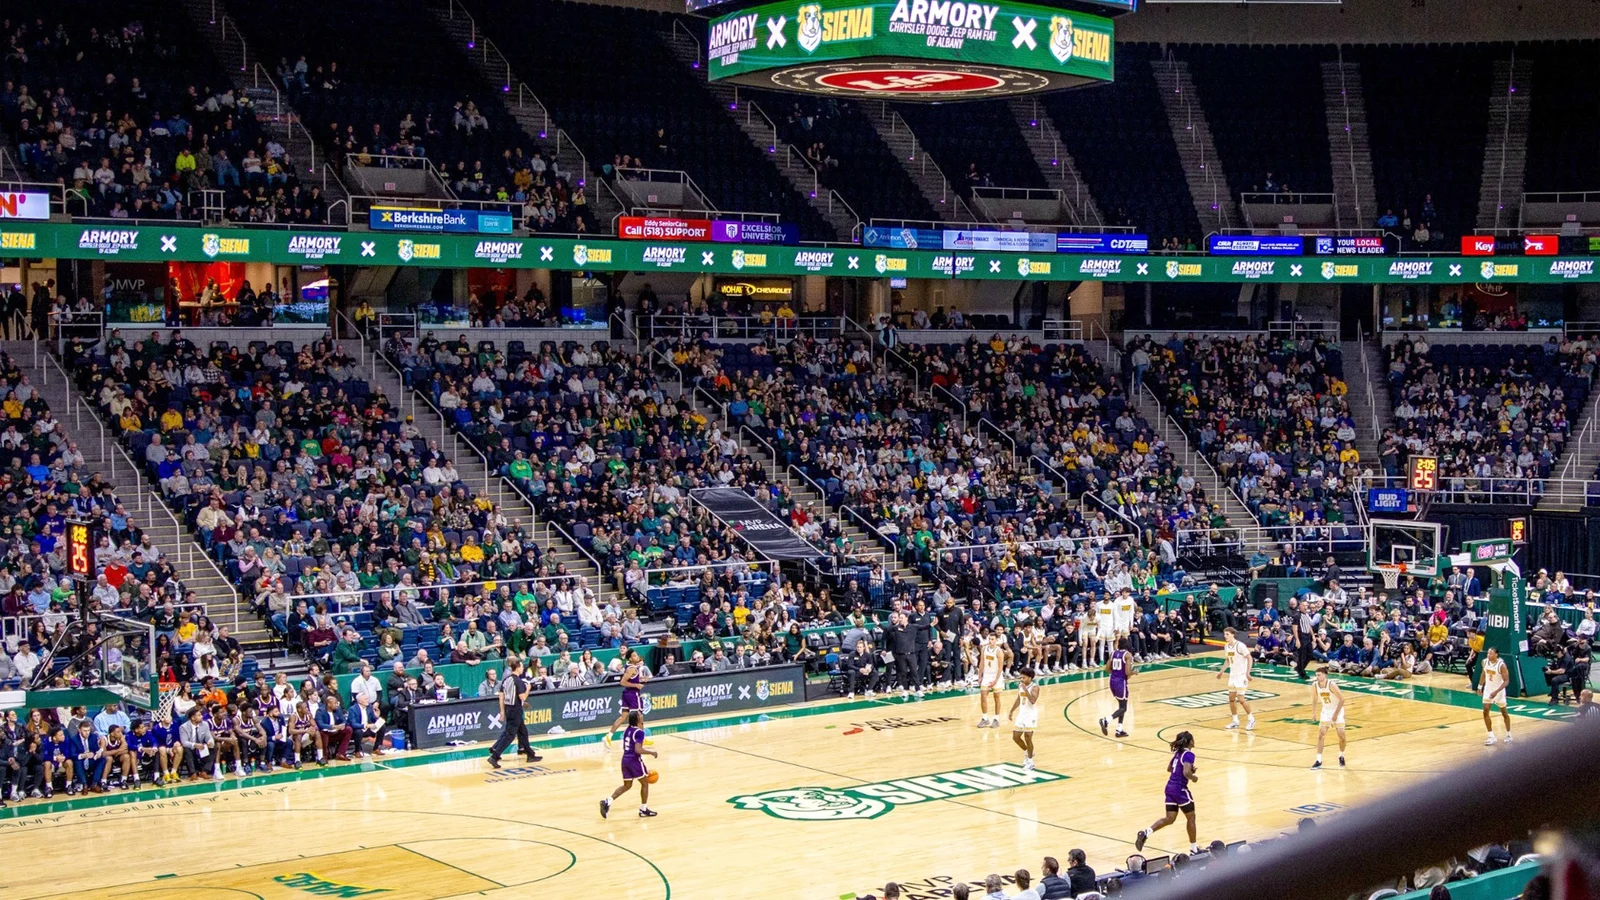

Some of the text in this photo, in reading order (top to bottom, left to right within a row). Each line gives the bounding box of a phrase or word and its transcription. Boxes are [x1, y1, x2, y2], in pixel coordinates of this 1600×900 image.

[709, 13, 758, 50] ARMORY
[821, 7, 873, 42] SIENA
[889, 0, 999, 30] ARMORY
[1073, 29, 1110, 62] SIENA
[889, 21, 997, 41] CHRYSLER DODGE JEEP RAM FIAT
[927, 36, 964, 49] OF ALBANY
[625, 226, 706, 238] Call (518) SUPPORT
[659, 220, 688, 228] SeniorCare
[742, 224, 782, 233] EXCELSIOR
[1, 232, 35, 249] SIENA
[80, 230, 138, 244] ARMORY
[219, 239, 249, 254] SIENA
[742, 232, 787, 241] UNIVERSITY
[1110, 239, 1135, 249] CDTA
[289, 236, 342, 249] ARMORY
[413, 244, 440, 258] SIENA
[475, 242, 523, 254] ARMORY
[587, 249, 612, 263] SIENA
[643, 247, 687, 259] ARMORY
[744, 254, 767, 267] SIENA
[795, 252, 834, 263] ARMORY
[886, 258, 907, 271] SIENA
[933, 257, 974, 267] ARMORY
[1029, 262, 1051, 274] SIENA
[1080, 260, 1122, 271] ARMORY
[1178, 264, 1202, 276] SIENA
[1232, 262, 1275, 272] ARMORY
[1335, 265, 1358, 277] SIENA
[1390, 262, 1433, 272] ARMORY
[1494, 265, 1518, 276] SIENA
[1550, 261, 1594, 271] ARMORY
[116, 279, 145, 290] MVP
[1417, 459, 1435, 470] 2:05
[1414, 470, 1433, 488] 25
[1374, 500, 1401, 508] LIGHT
[1378, 493, 1398, 501] BUD
[746, 522, 783, 531] ARENA
[1511, 576, 1520, 634] TicketSmarter
[1112, 658, 1122, 670] 00
[687, 683, 733, 699] ARMORY
[769, 680, 794, 697] SIENA
[562, 696, 612, 713] ARMORY
[651, 694, 677, 710] SIENA
[427, 711, 481, 729] ARMORY
[524, 708, 552, 725] SIENA
[624, 737, 630, 751] 2
[855, 763, 1050, 803] SIENA
